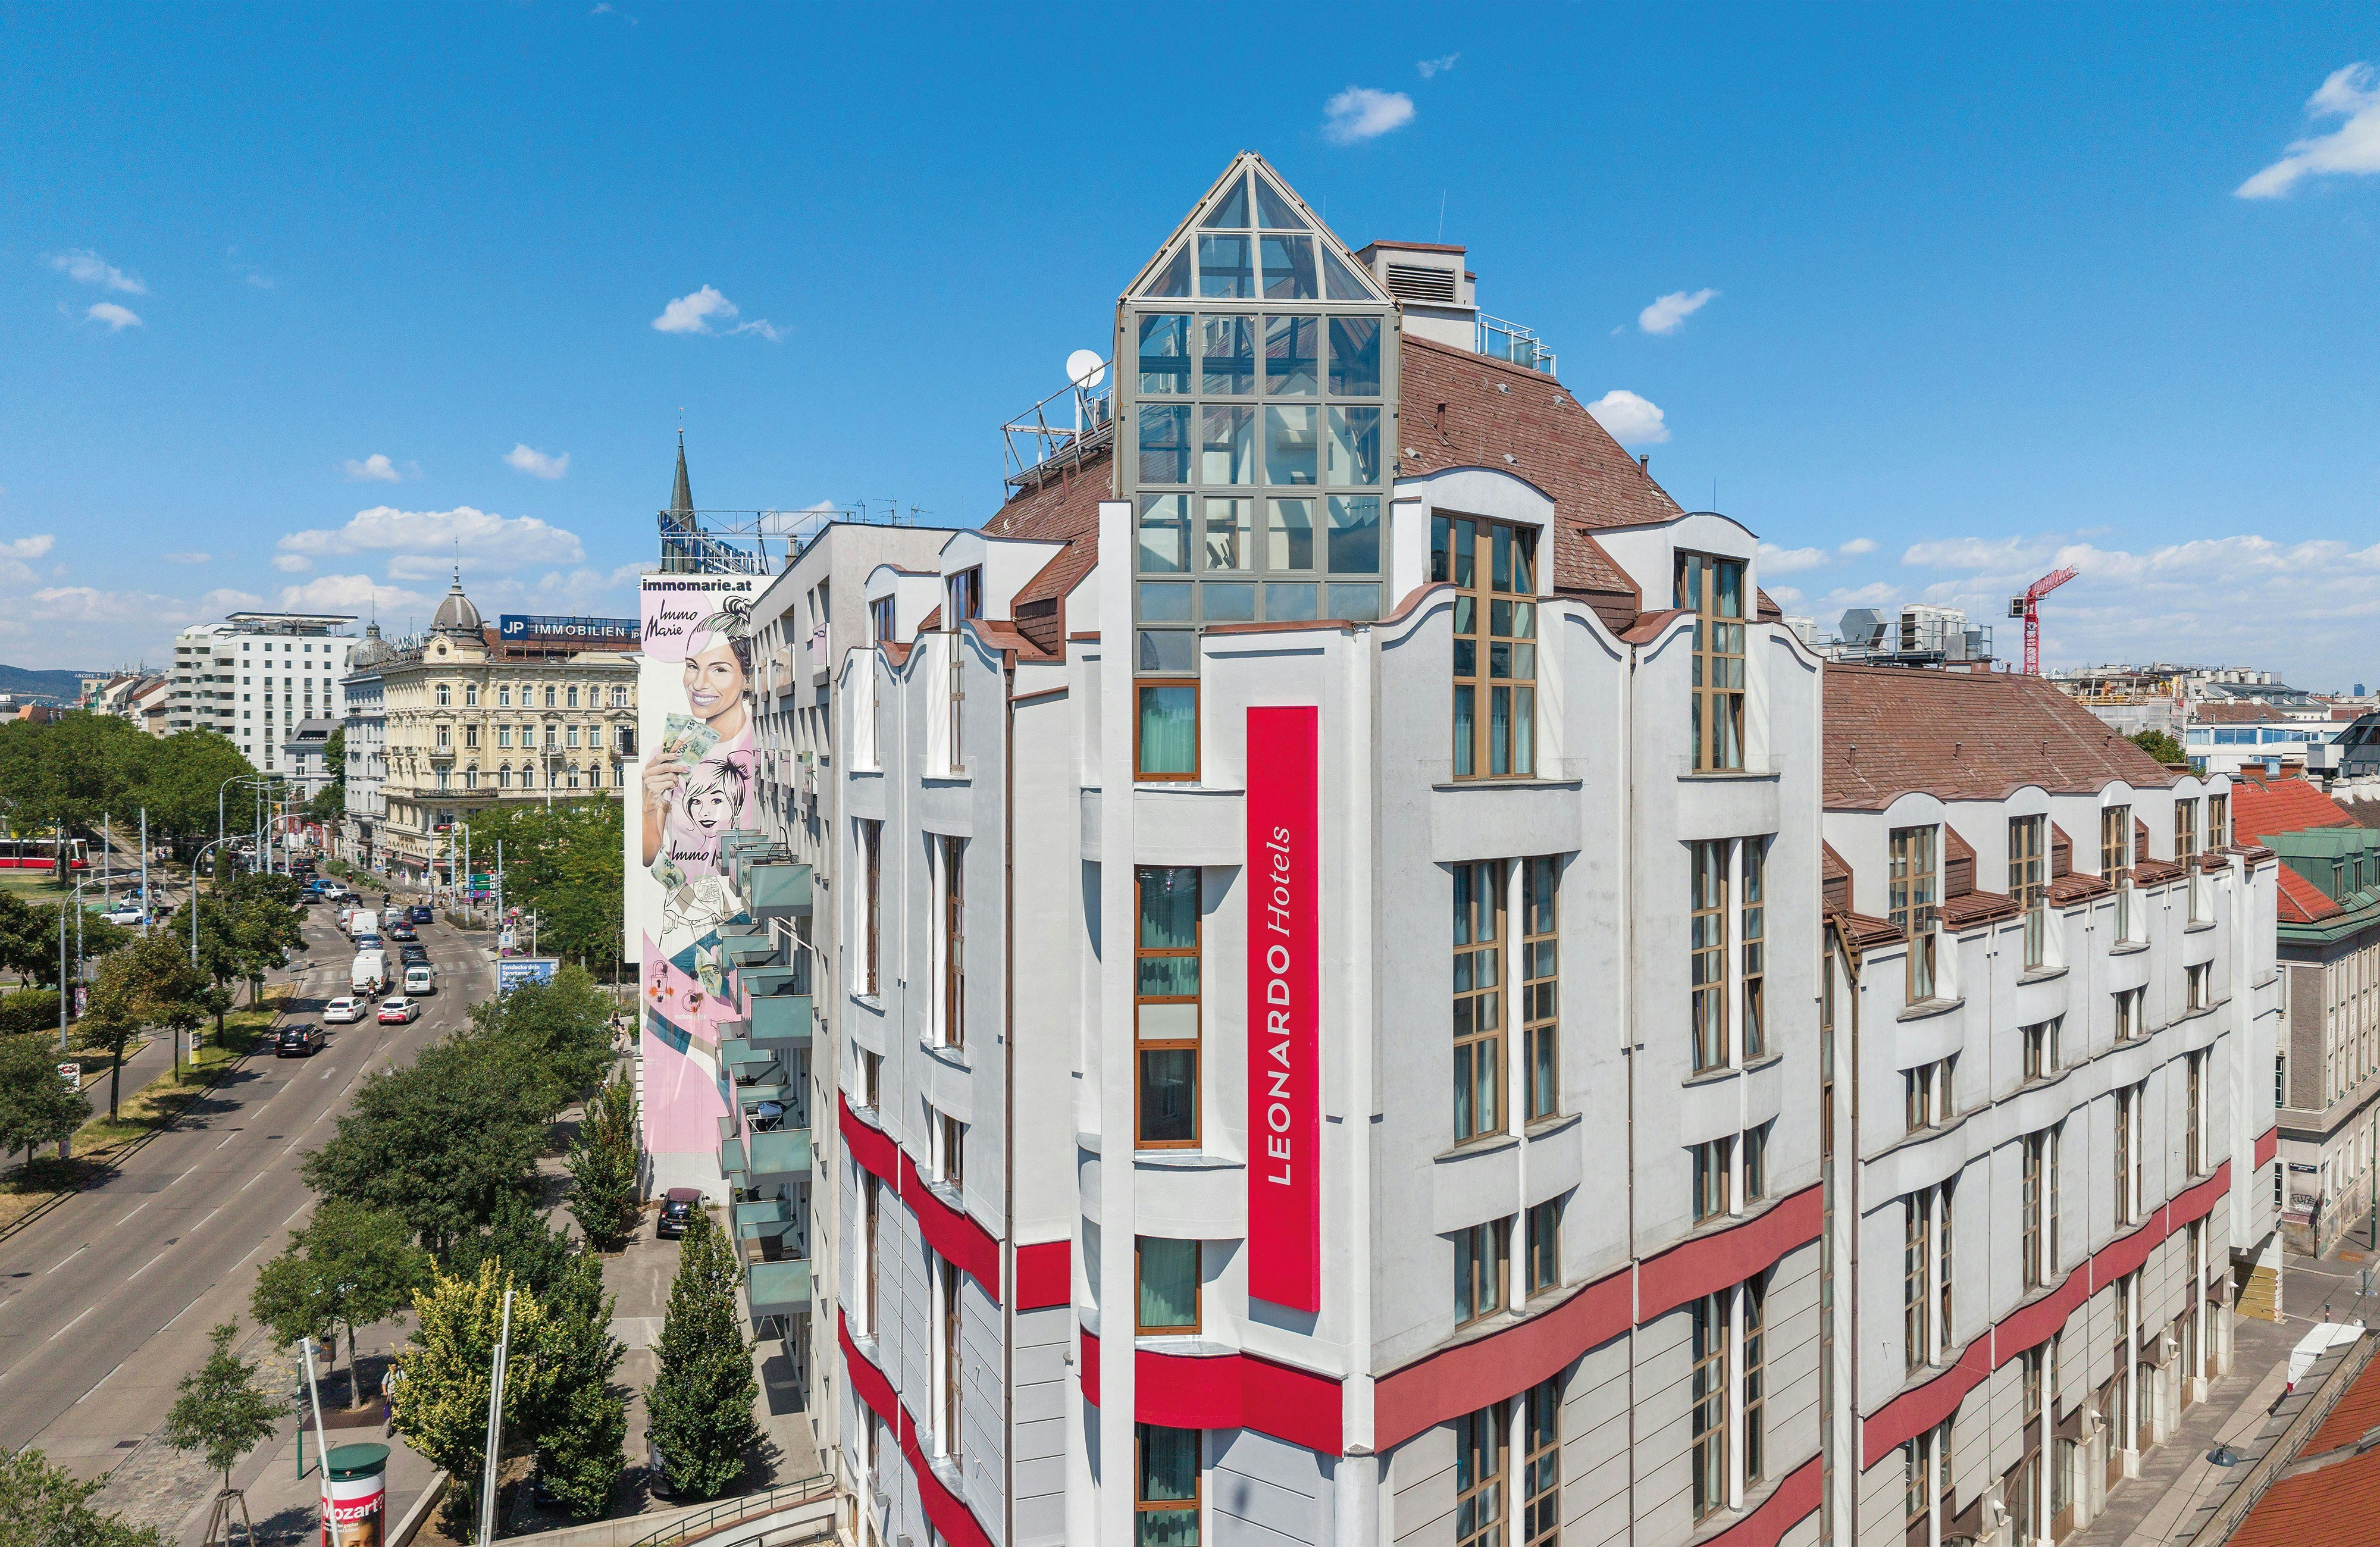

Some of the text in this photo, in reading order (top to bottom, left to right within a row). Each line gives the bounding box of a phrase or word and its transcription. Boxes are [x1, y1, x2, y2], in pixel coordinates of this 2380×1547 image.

[643, 579, 752, 591] immomarie.at
[660, 599, 699, 621] Immo
[503, 621, 524, 634] JP
[535, 624, 625, 637] IMMOBILIEN
[644, 615, 684, 642] Marie
[671, 840, 710, 861] Immo
[1266, 825, 1291, 1186] LEONARDO Hotels
[322, 1493, 384, 1520] Mozart?
